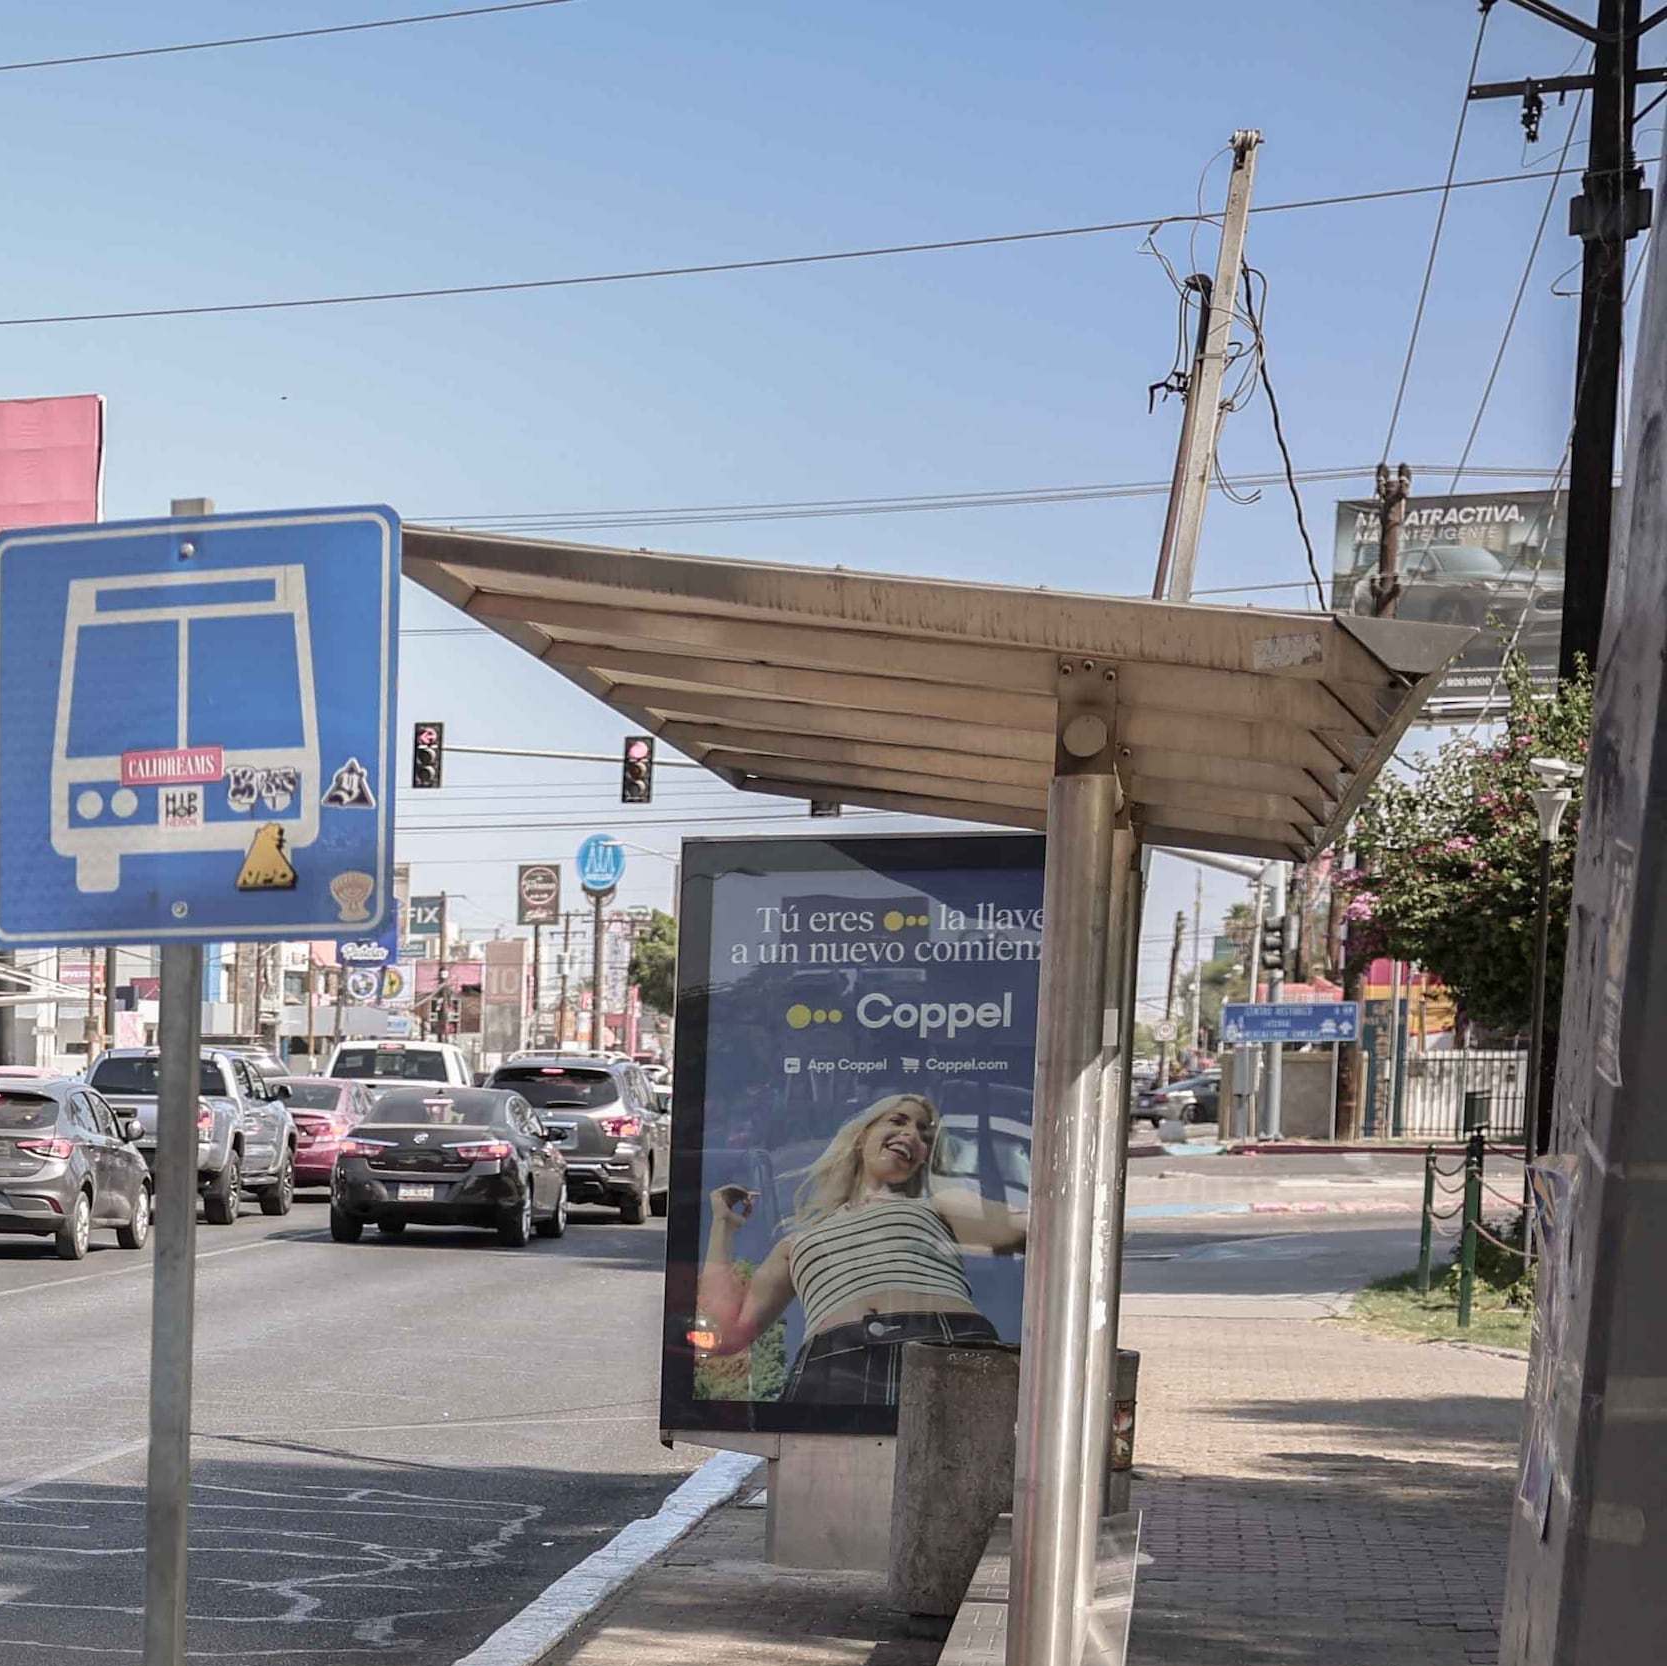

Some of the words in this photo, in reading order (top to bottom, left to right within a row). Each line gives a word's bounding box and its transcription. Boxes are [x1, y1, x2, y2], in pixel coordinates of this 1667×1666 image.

[1404, 505, 1525, 526] ATRACTIVA,
[128, 756, 215, 779] CALIDREAMS
[756, 905, 801, 933] Tú
[809, 911, 875, 933] eres
[938, 903, 970, 931] la
[731, 943, 750, 963] a
[758, 943, 799, 964] un
[808, 941, 905, 963] nuevo
[856, 992, 1012, 1038] Coppel
[807, 1059, 835, 1072] App
[838, 1058, 888, 1072] Coppel
[925, 1058, 1008, 1072] Coppel.com
